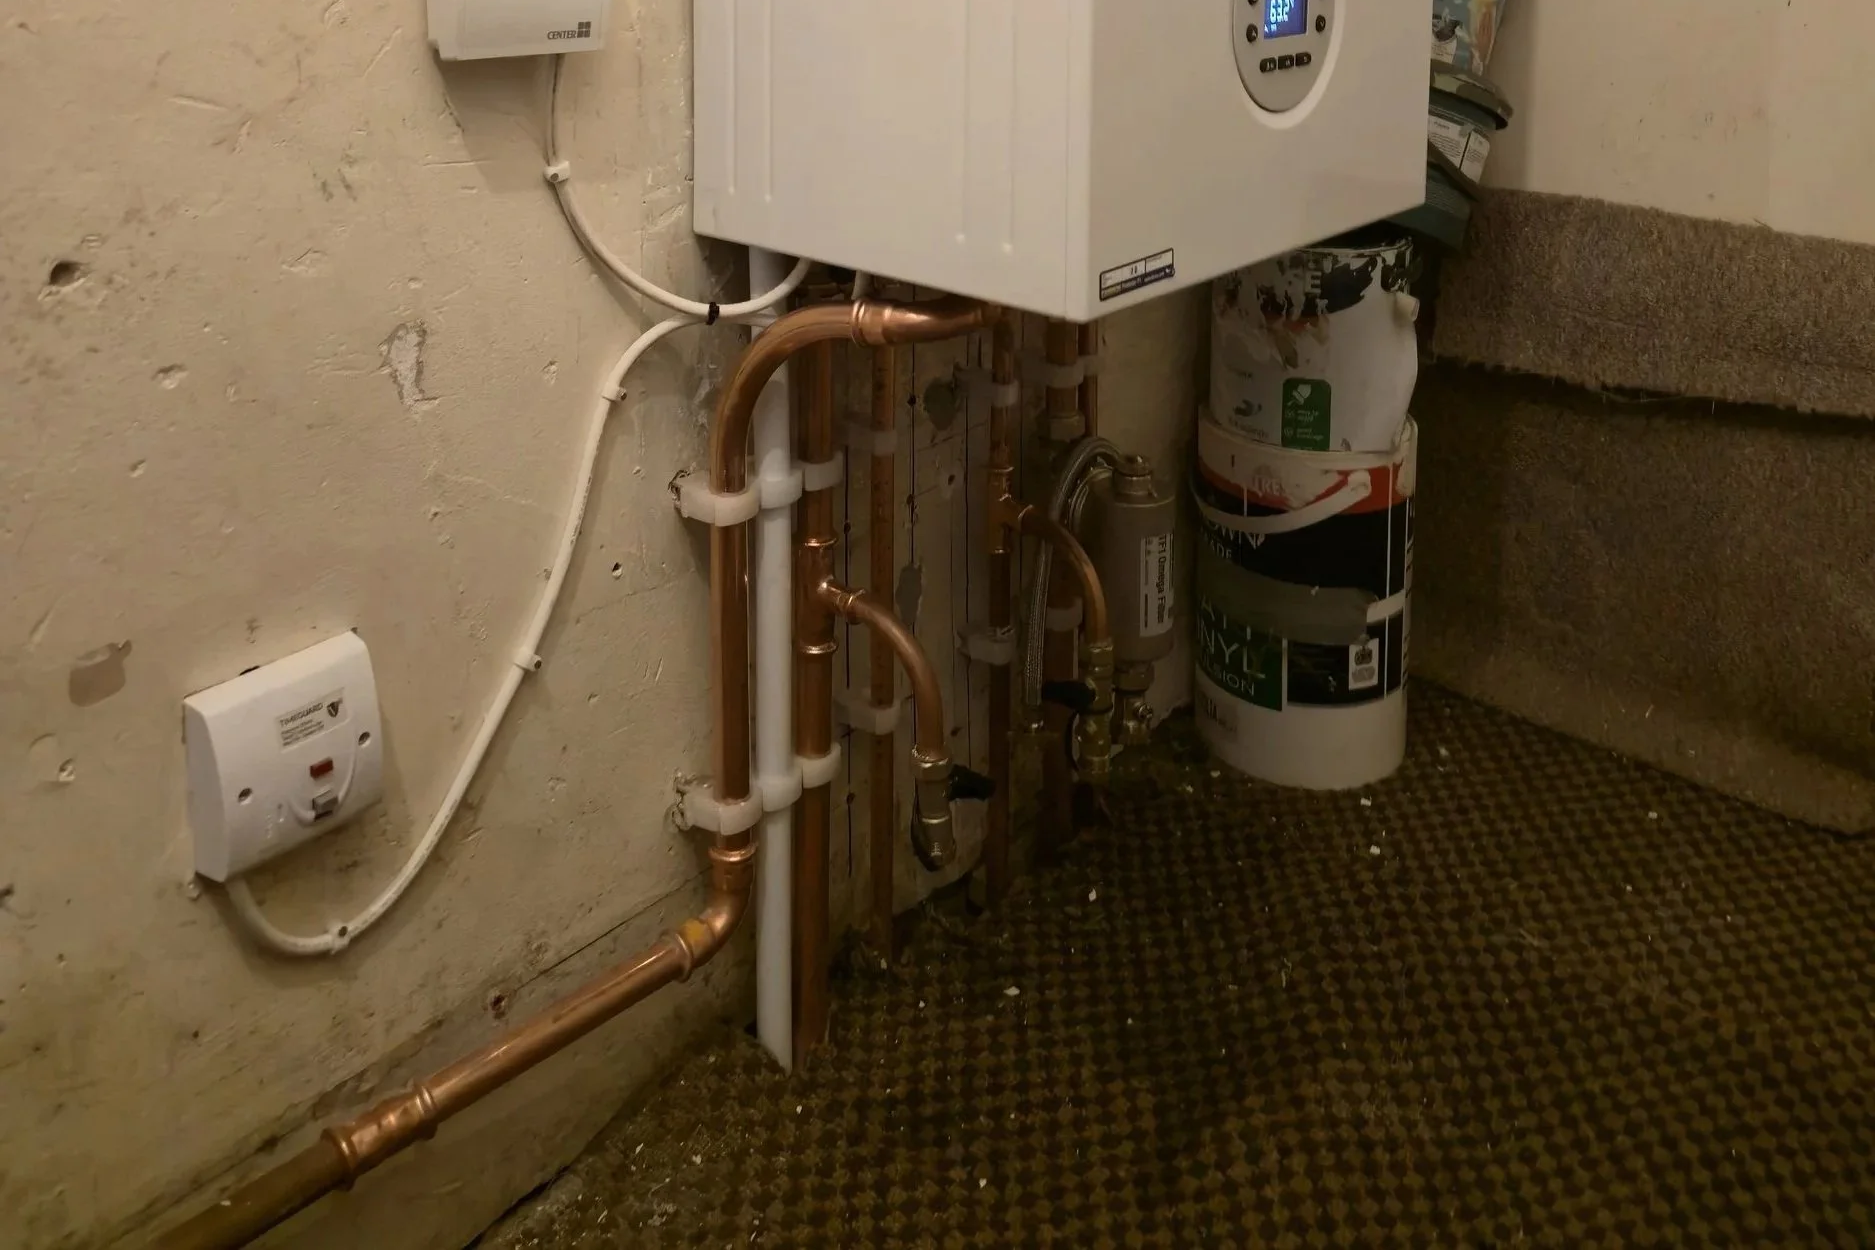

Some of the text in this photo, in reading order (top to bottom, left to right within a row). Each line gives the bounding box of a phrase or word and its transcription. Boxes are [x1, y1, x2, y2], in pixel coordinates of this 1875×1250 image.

[1158, 534, 1167, 554] TF1
[1156, 556, 1167, 594] Omega
[280, 702, 324, 727] TIMEGUARD
